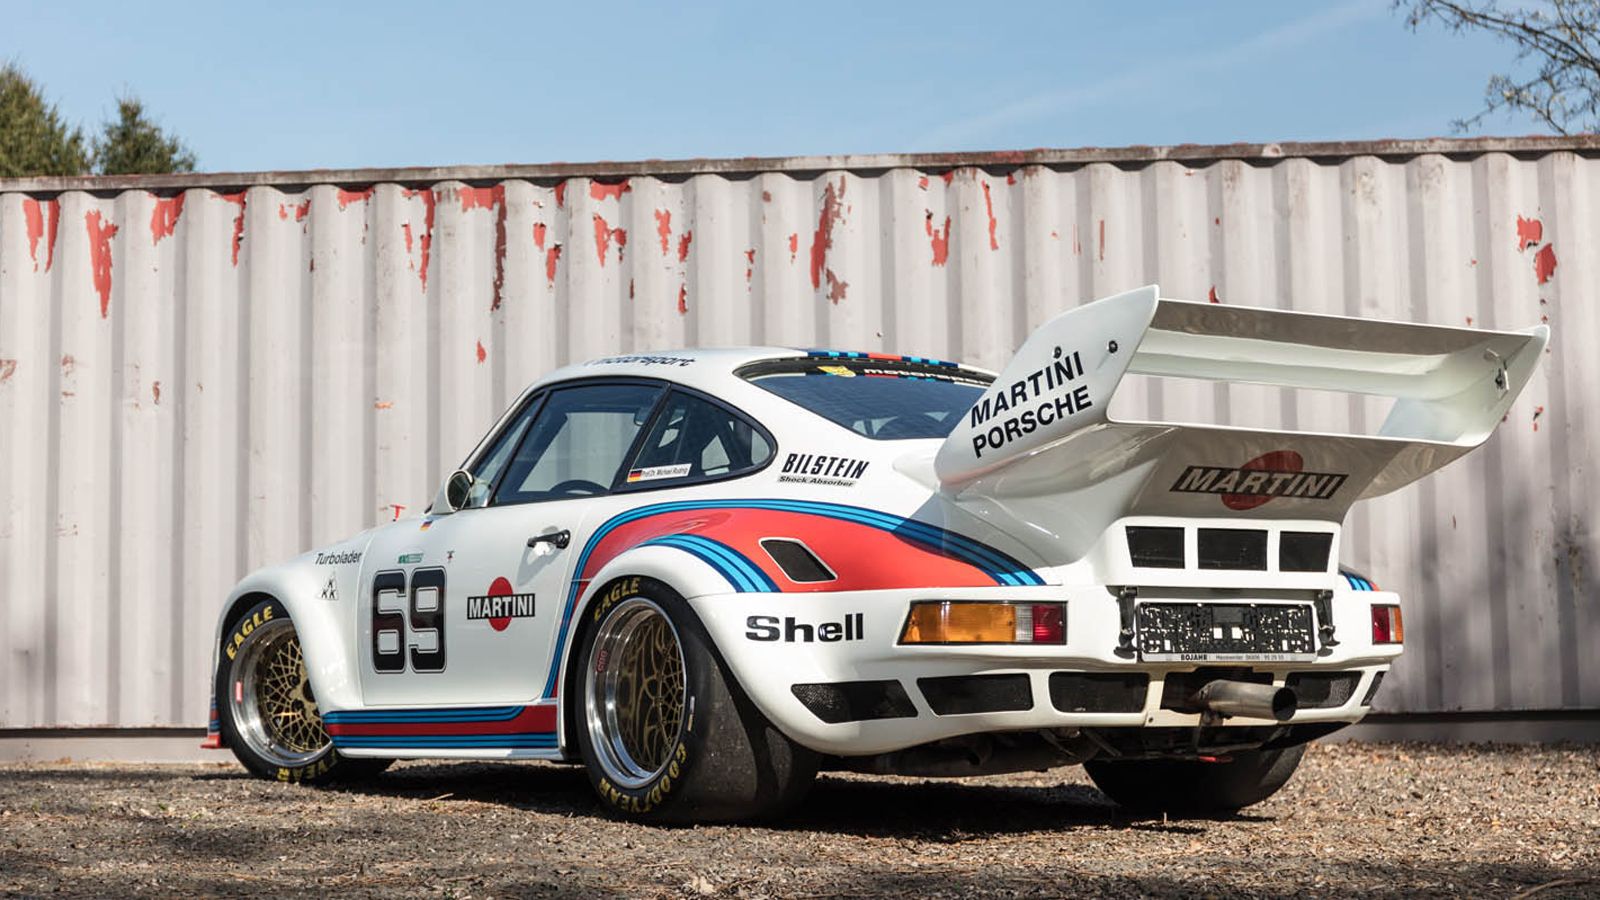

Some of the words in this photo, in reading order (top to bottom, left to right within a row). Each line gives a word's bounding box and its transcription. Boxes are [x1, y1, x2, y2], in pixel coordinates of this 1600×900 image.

[863, 368, 994, 387] motorspor
[971, 351, 1084, 428] MARTINI
[972, 385, 1093, 459] PORSCHE
[779, 475, 807, 484] Shock
[810, 478, 854, 487] Absorber
[781, 453, 870, 479] BILSTEIN
[1178, 468, 1342, 497] MARTINI
[315, 549, 362, 565] Turbolader
[469, 595, 534, 619] MARTINI
[594, 577, 640, 622] EAGLE
[226, 605, 273, 660] EAGLE
[371, 565, 447, 675] 69
[745, 612, 864, 643] Shell
